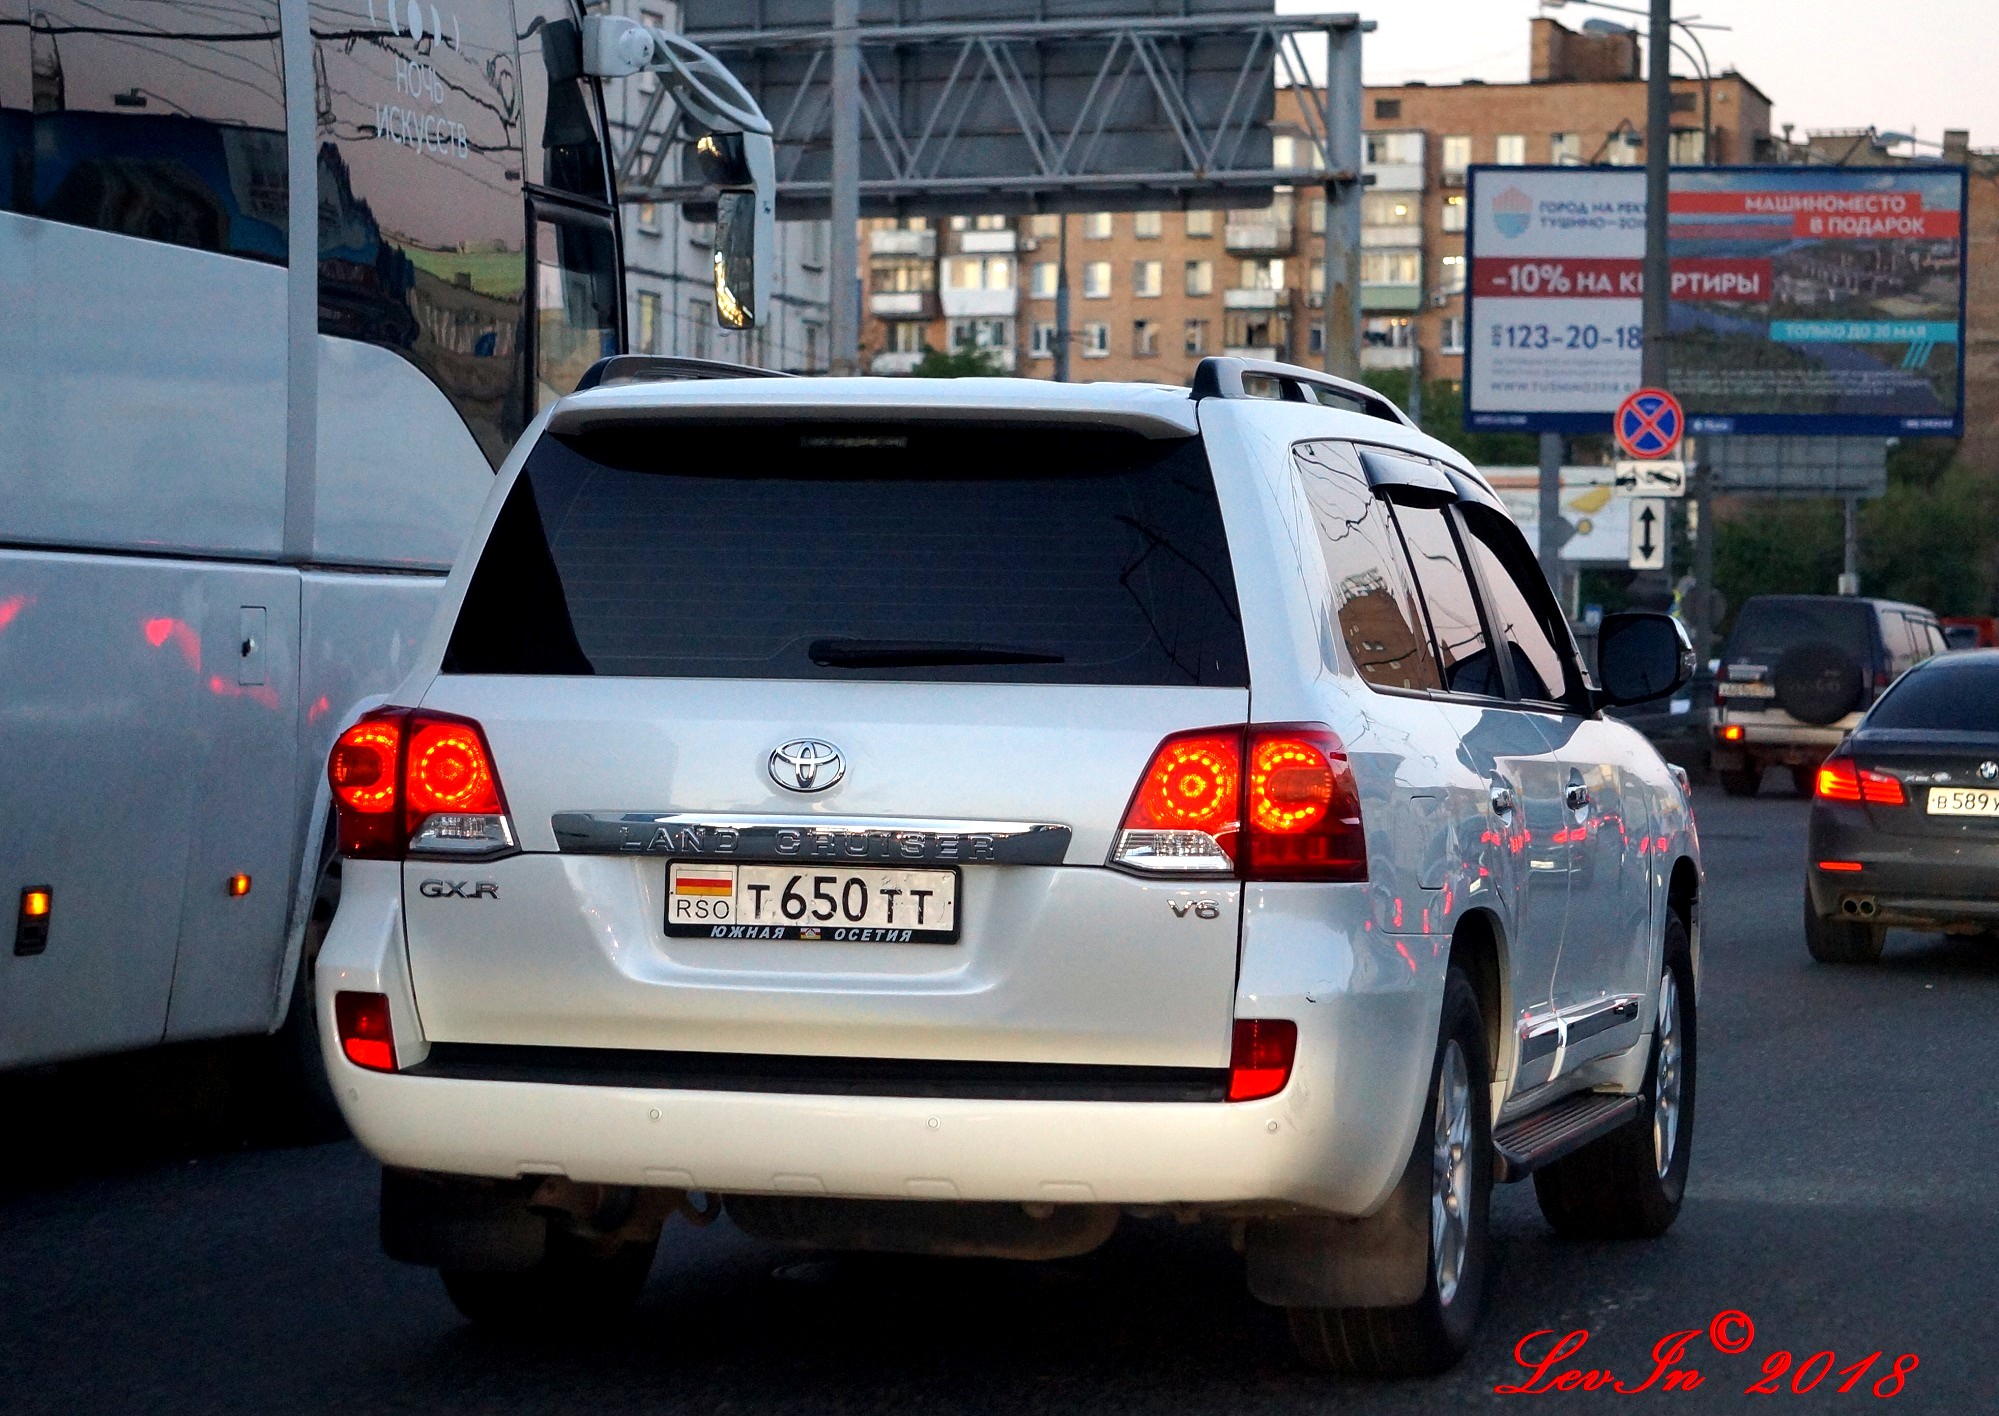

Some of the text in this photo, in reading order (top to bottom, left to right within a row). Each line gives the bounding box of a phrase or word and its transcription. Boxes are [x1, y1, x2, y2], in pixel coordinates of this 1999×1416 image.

[395, 57, 444, 104] НОЧЬ
[375, 103, 468, 159] ИСКУССТВ
[1744, 195, 1906, 213] МАШИНОМЕСТО
[1809, 217, 1925, 236] В ПОДАРОК
[1492, 264, 1572, 293] -10%
[1576, 272, 1613, 293] НА
[619, 827, 996, 860] LAND CRUISER
[420, 879, 499, 899] GXR
[675, 898, 730, 920] RSO
[710, 925, 912, 942] ЮЖНАЯ ОСЕТИЯ
